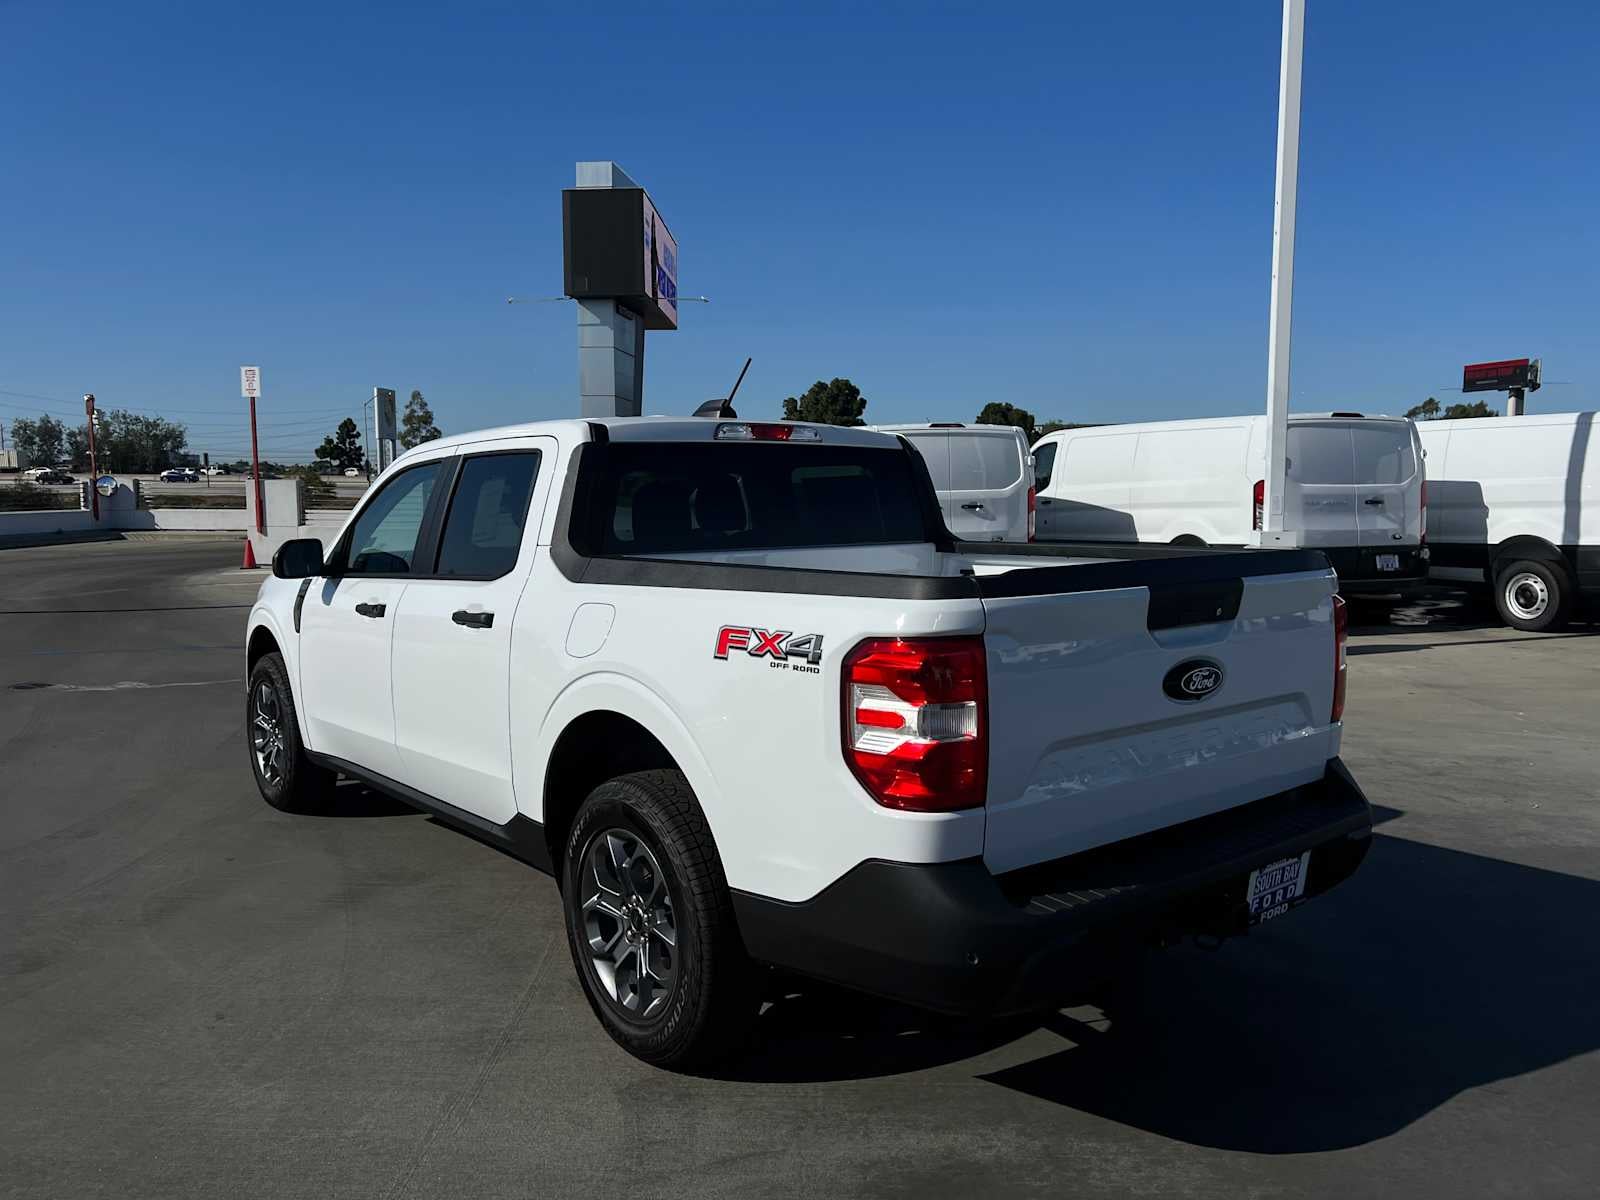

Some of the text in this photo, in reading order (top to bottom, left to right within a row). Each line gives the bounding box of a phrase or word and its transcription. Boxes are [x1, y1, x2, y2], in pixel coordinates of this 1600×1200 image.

[713, 624, 824, 665] FX4
[769, 661, 820, 674] OFF ROAD
[1189, 670, 1215, 690] Ford
[1254, 869, 1282, 893] SOUTH
[1283, 863, 1299, 882] BAY
[1252, 884, 1295, 912] FORD
